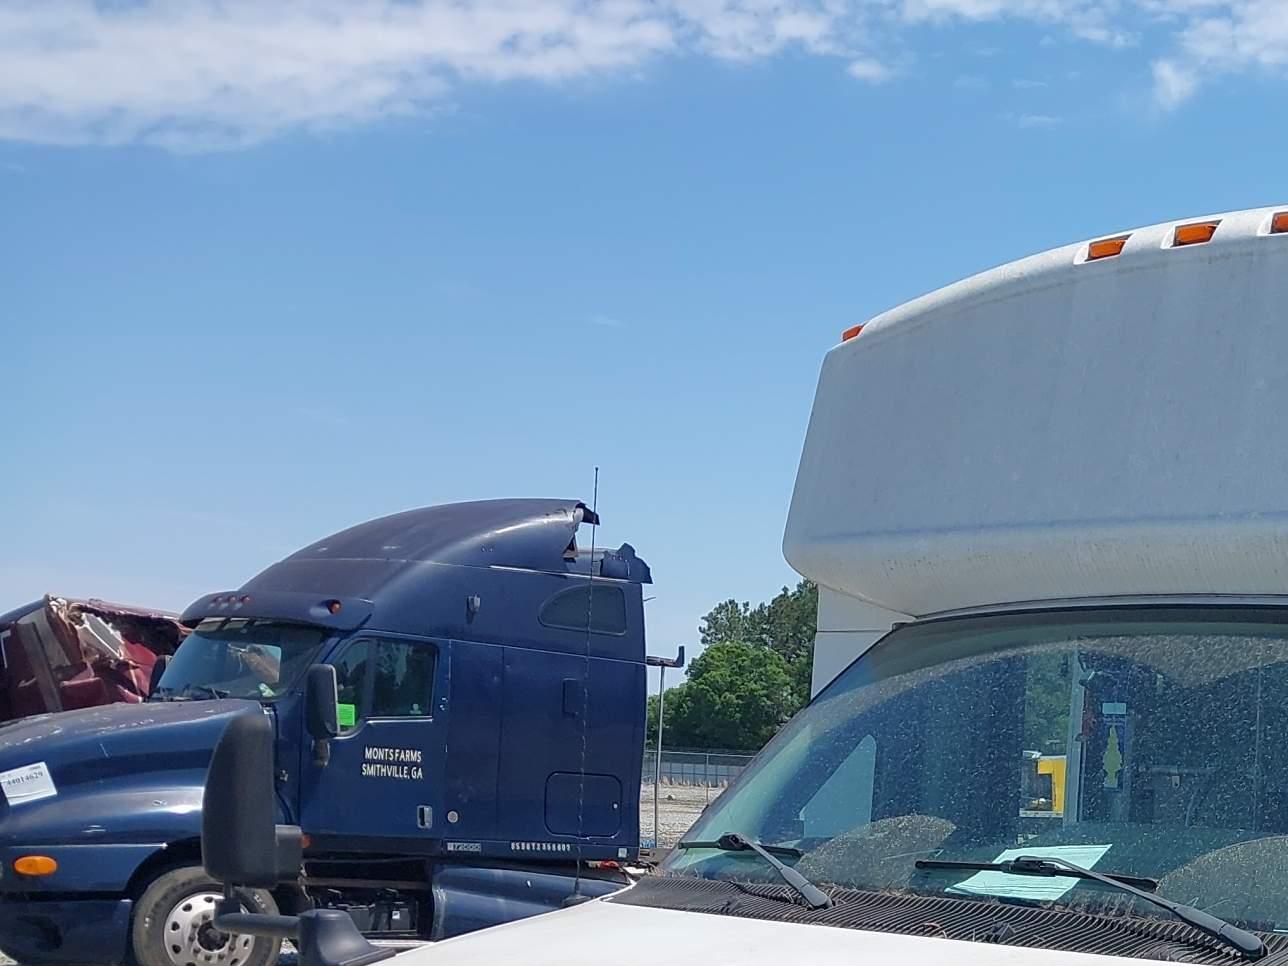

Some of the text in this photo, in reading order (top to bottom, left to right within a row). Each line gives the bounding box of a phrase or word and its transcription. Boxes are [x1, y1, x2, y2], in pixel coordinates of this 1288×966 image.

[365, 746, 422, 762] MONTS FARMS
[411, 767, 423, 779] GA
